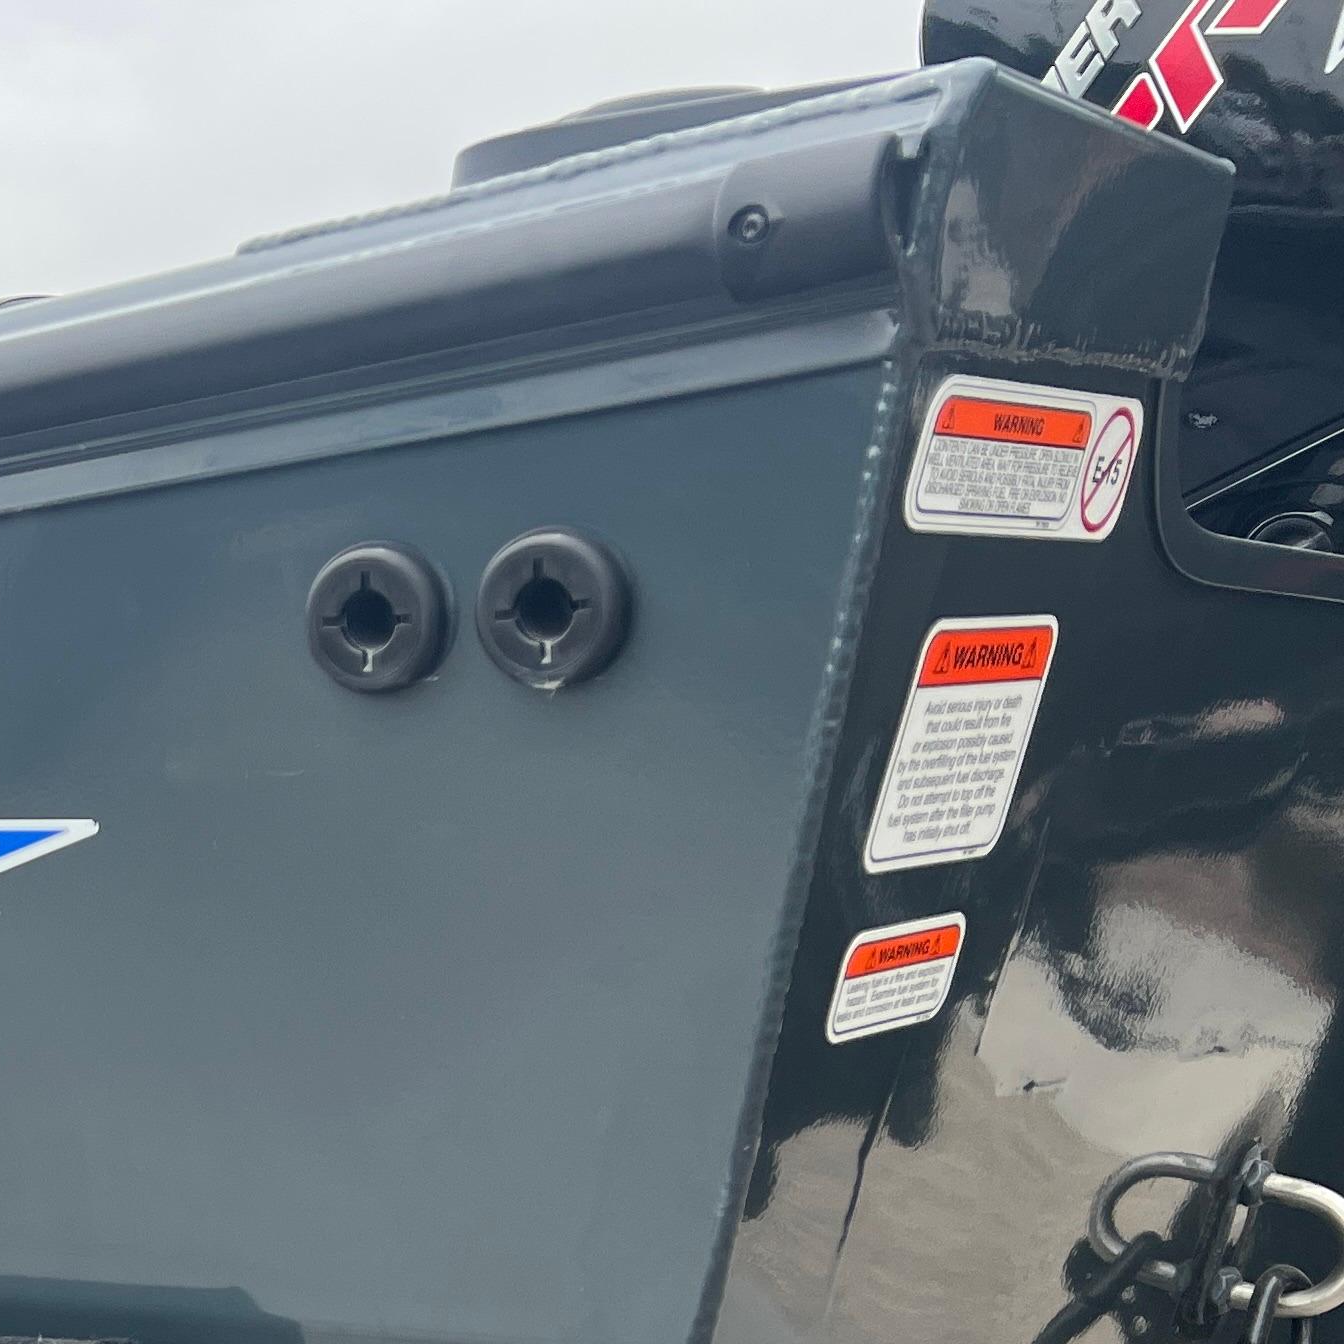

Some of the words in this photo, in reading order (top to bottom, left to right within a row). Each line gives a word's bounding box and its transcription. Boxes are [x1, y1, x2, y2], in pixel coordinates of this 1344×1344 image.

[993, 412, 1046, 437] WARNING
[953, 643, 1025, 670] WARNING
[878, 939, 931, 964] WARNING
